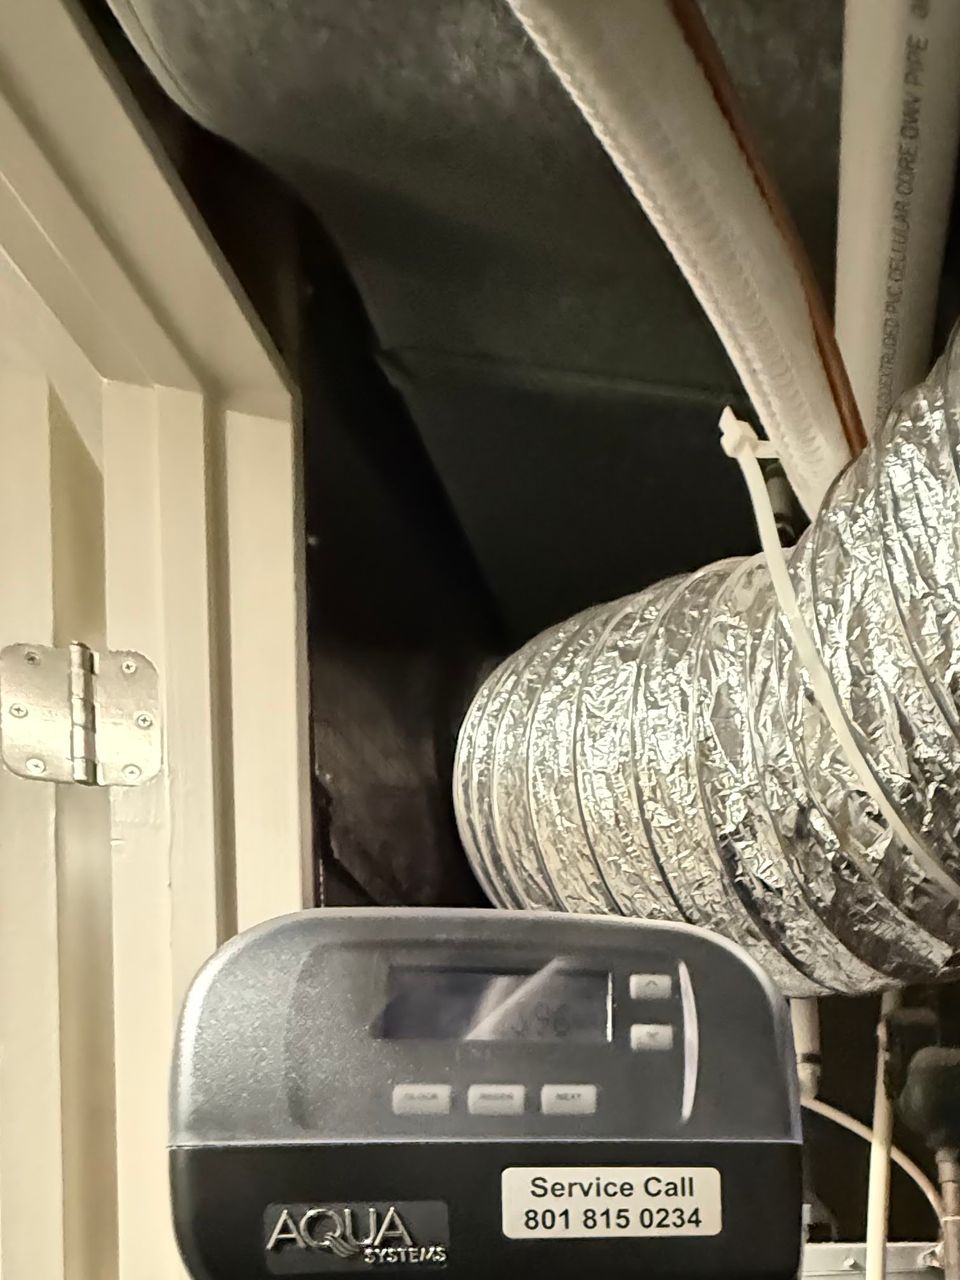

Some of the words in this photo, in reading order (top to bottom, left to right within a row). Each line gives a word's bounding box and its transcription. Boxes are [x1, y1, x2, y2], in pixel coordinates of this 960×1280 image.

[530, 1177, 634, 1198] Service
[643, 1177, 694, 1197] Call
[524, 1208, 570, 1230] 801
[583, 1208, 631, 1229] 815
[639, 1207, 702, 1229] 0234
[265, 1207, 413, 1258] AQUA
[364, 1246, 447, 1263] SYSTEMS
